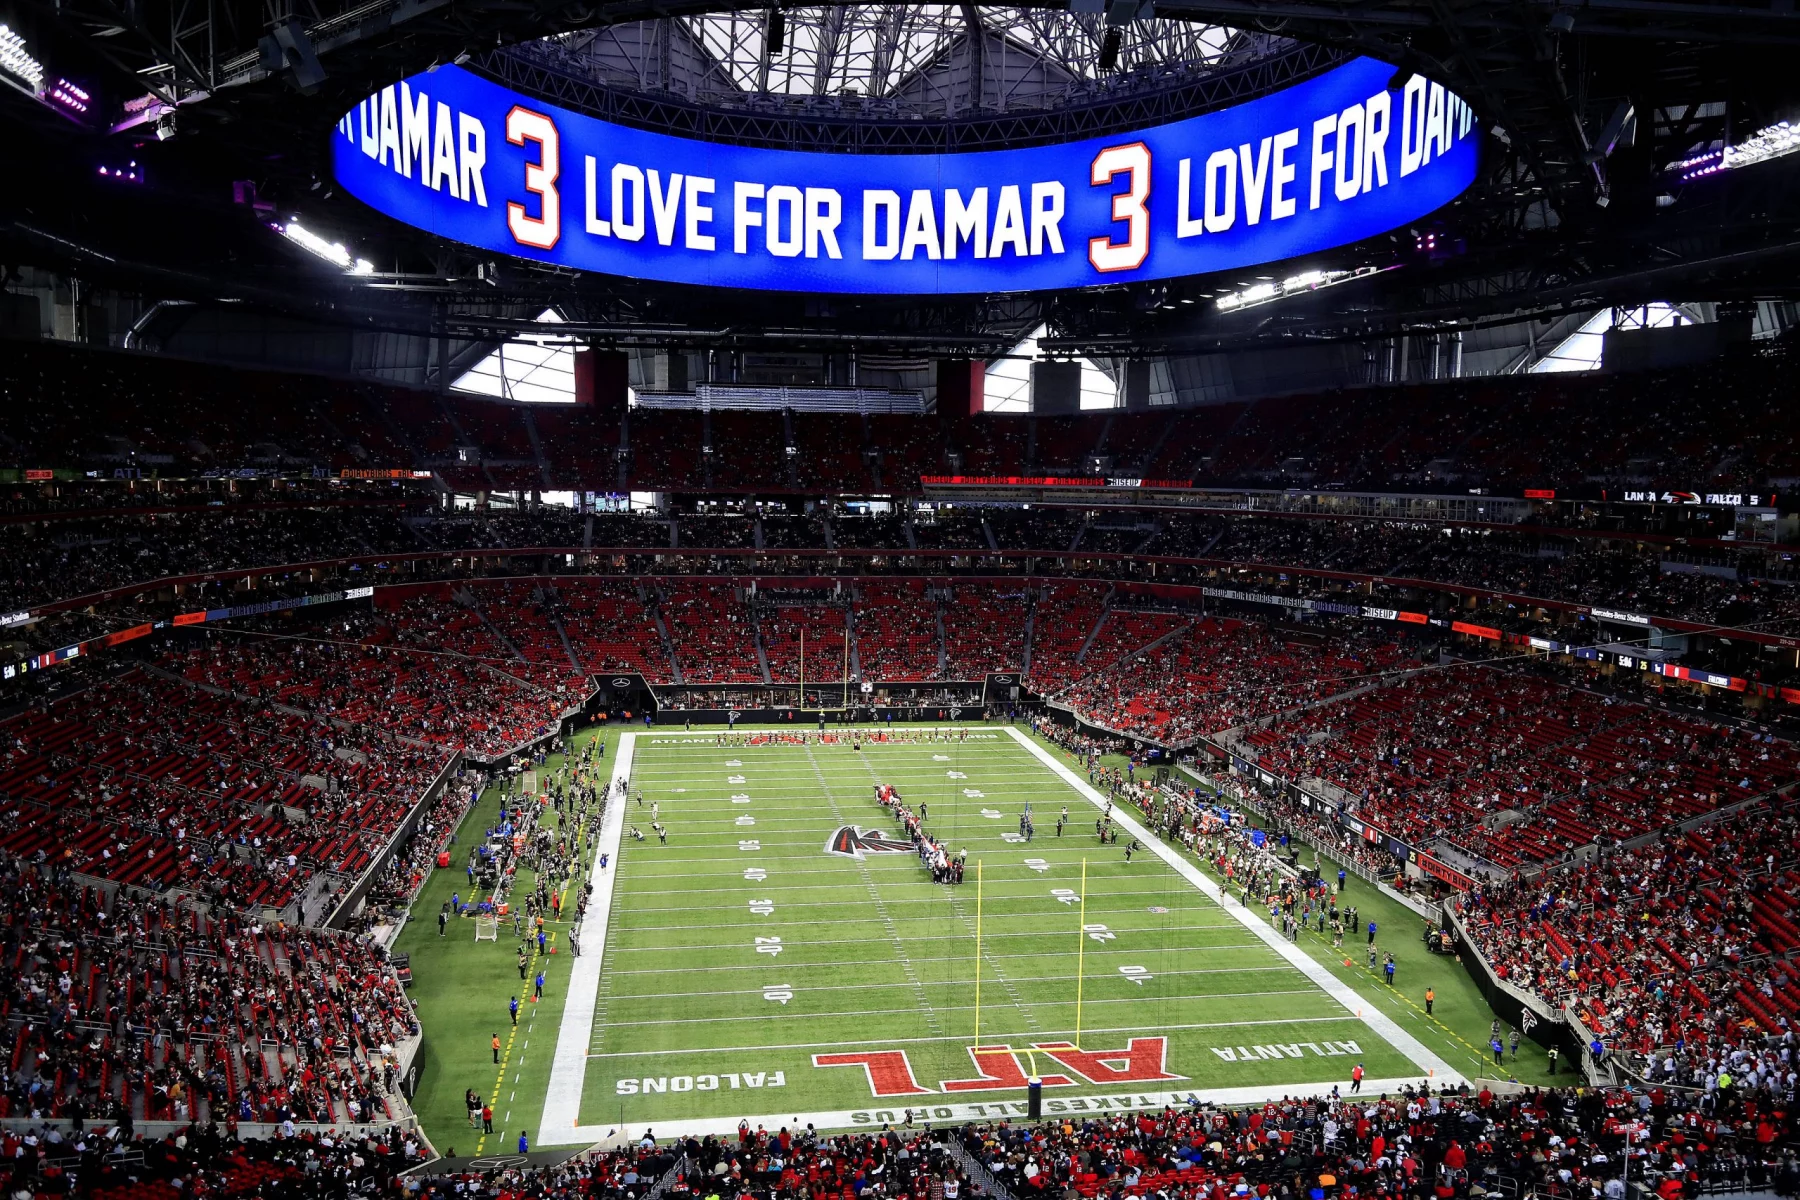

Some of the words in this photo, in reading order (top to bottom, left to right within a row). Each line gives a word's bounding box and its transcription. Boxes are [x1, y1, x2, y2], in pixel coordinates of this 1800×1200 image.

[361, 81, 487, 207] DAMAR
[506, 105, 560, 250] 3
[585, 155, 716, 251] LOVE
[733, 181, 843, 260] FOR
[862, 181, 1066, 260] DAMAR
[1088, 141, 1152, 273] 3
[1176, 127, 1299, 239] LOVE
[1309, 89, 1391, 210] FOR
[1400, 73, 1477, 178] DAM
[1624, 491, 1656, 501] LANA
[1051, 889, 1081, 903] 30
[749, 899, 774, 913] 30
[1083, 924, 1117, 940] 20
[755, 936, 783, 953] 20
[1118, 965, 1154, 981] 10
[762, 983, 793, 1001] 10
[1210, 1040, 1364, 1062] ATLANTA
[616, 1071, 786, 1095] FALCONS
[1047, 1095, 1156, 1112] TAKES
[851, 1110, 896, 1123] US
[912, 1107, 953, 1120] OF
